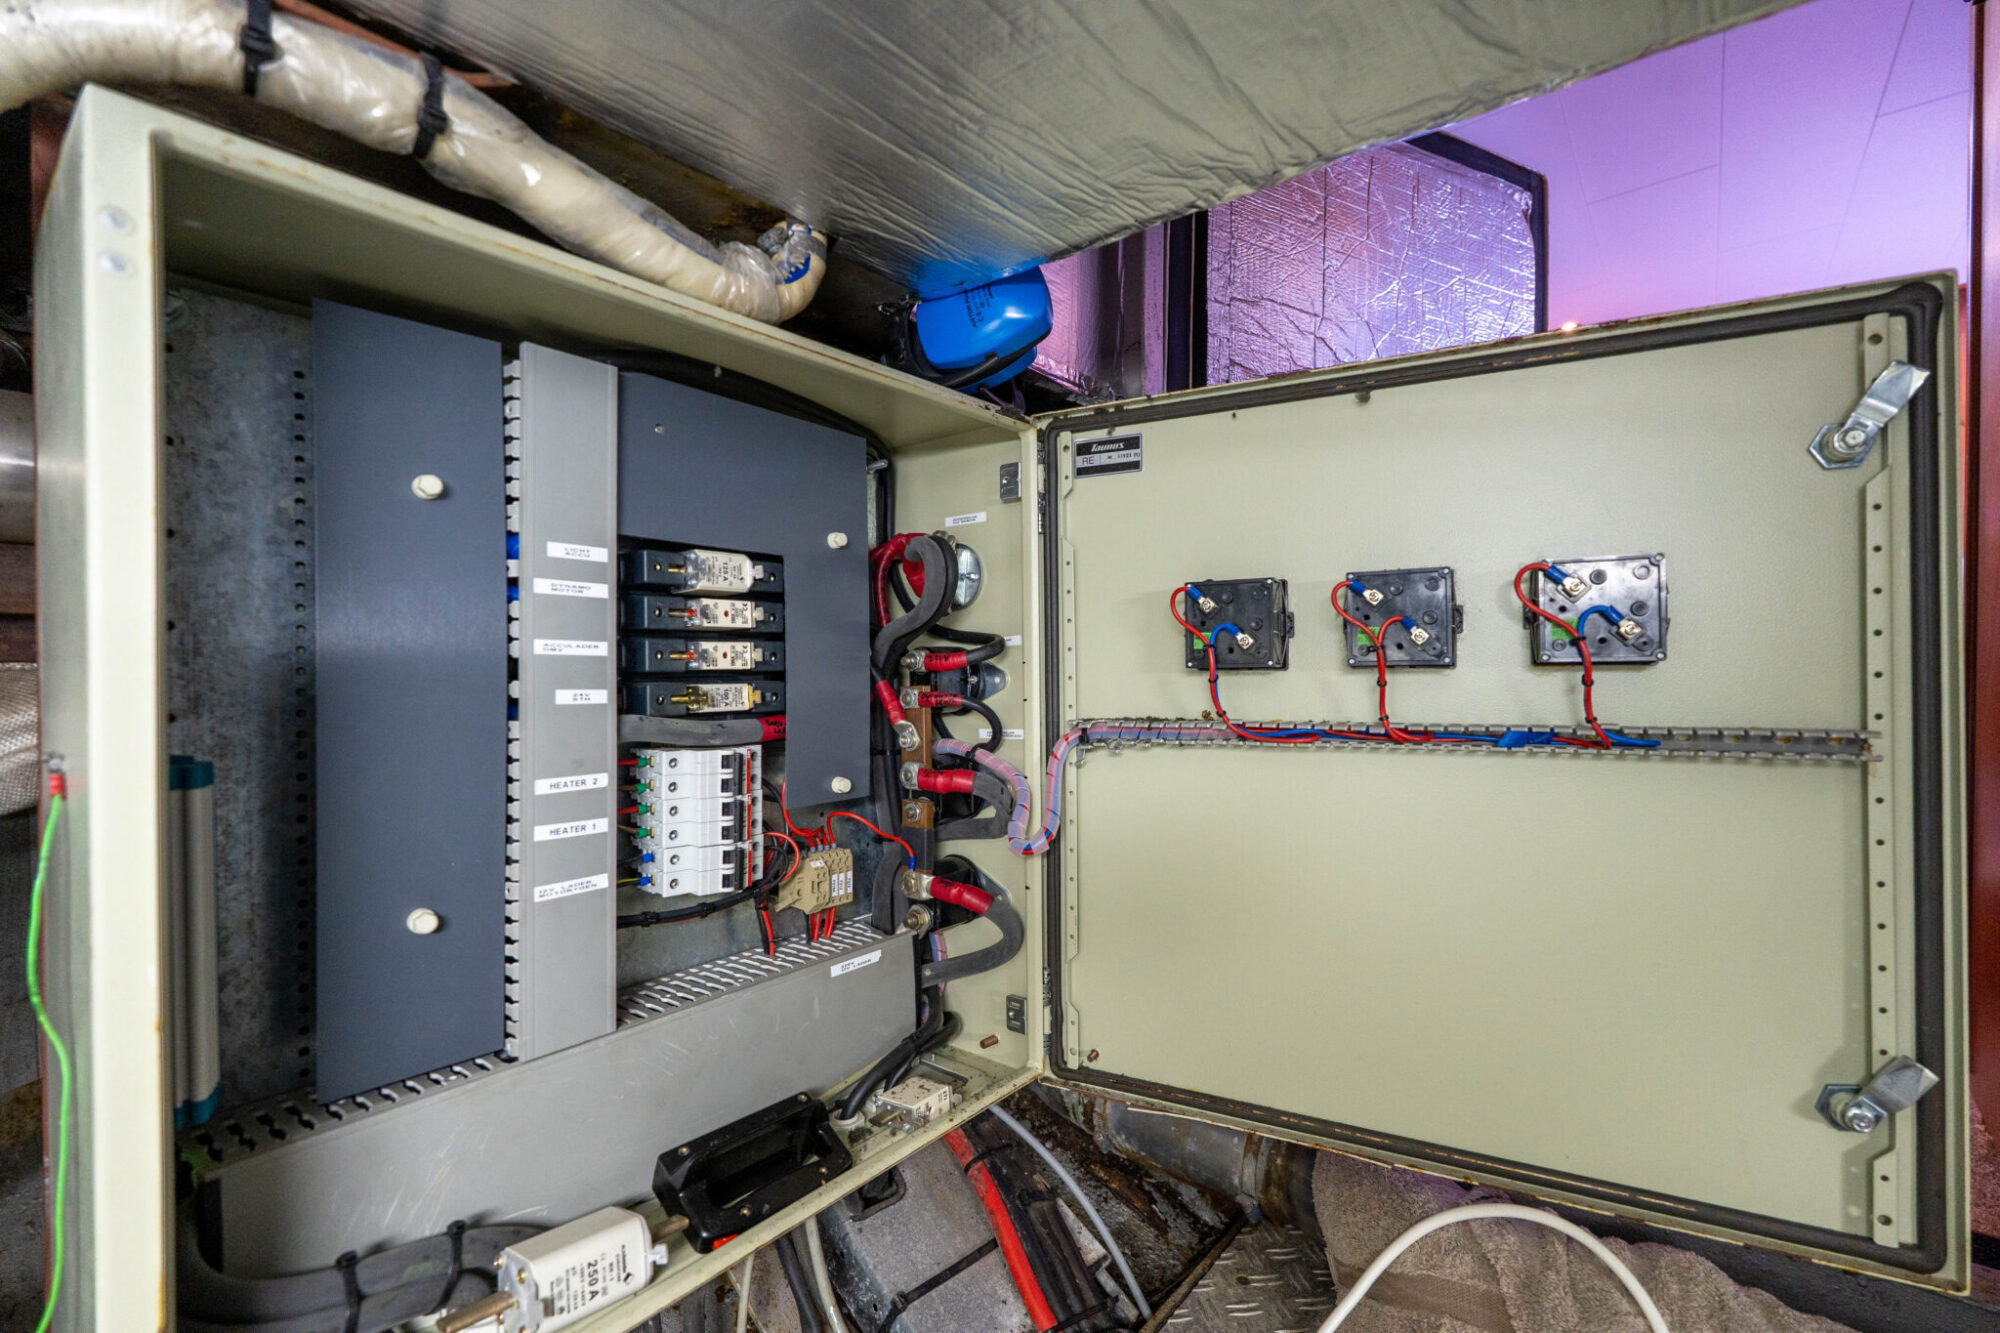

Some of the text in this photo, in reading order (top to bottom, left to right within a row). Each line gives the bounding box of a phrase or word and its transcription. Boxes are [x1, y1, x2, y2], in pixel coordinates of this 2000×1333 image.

[549, 777, 598, 790] HEATER 2
[549, 824, 587, 836] HEATER
[587, 1259, 599, 1302] 250 A
